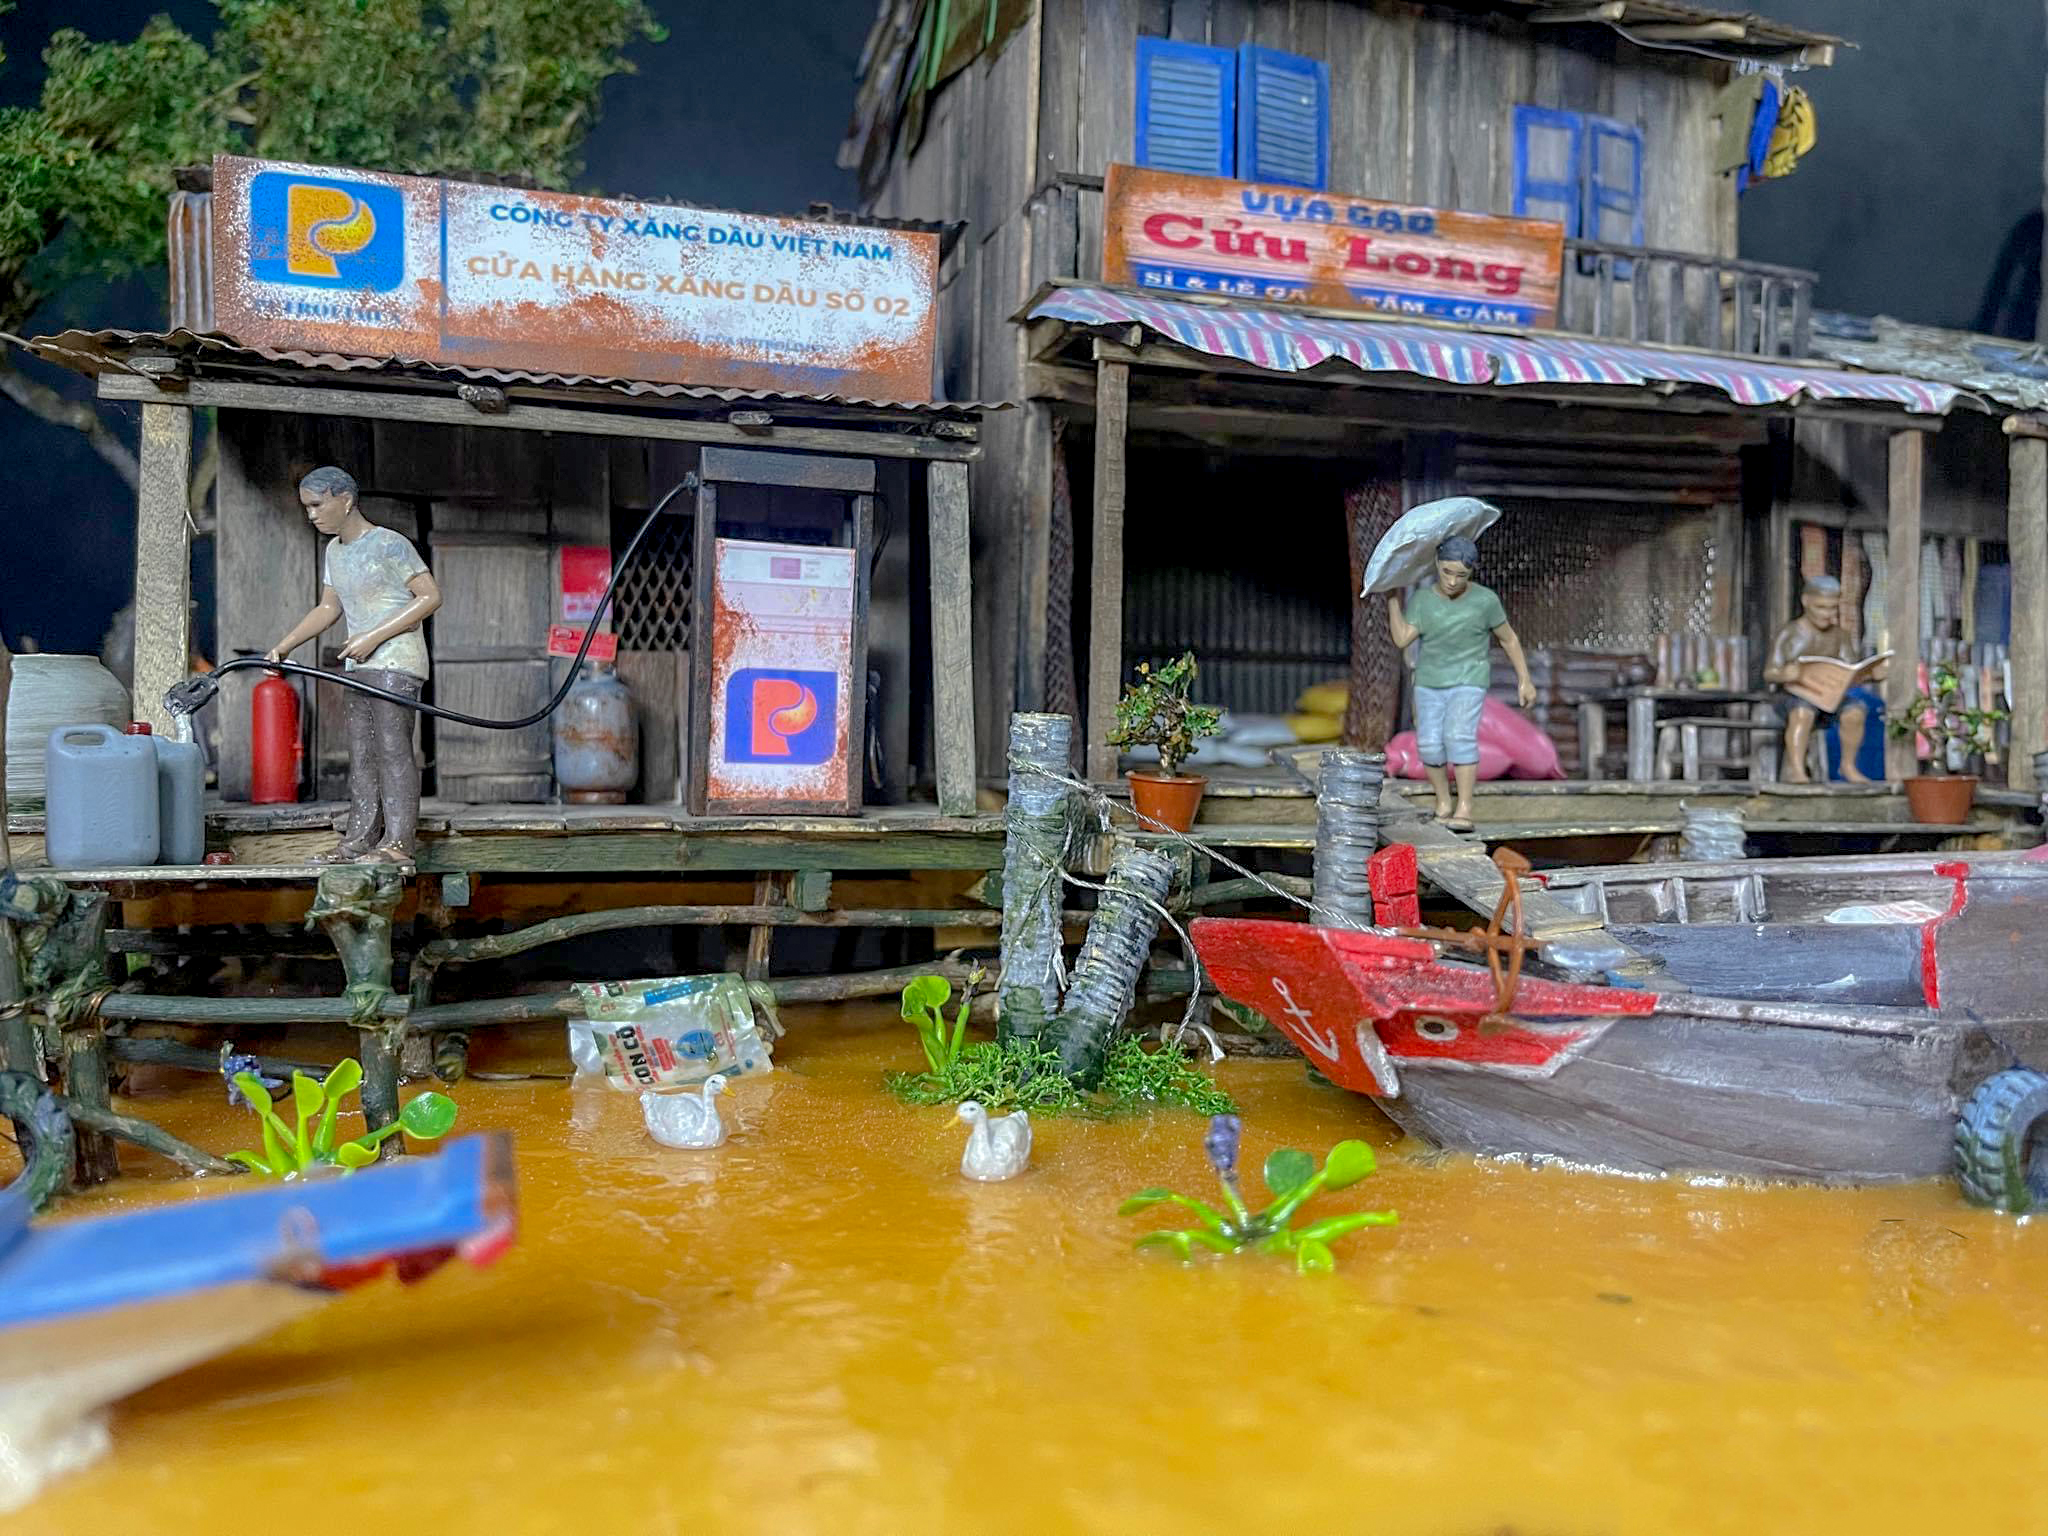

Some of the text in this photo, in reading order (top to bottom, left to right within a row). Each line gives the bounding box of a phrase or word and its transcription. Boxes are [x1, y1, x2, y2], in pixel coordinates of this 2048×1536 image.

[489, 202, 574, 229] CÔNG
[581, 212, 615, 233] TY
[708, 223, 764, 248] DẦU
[770, 232, 827, 257] VIỆT
[832, 240, 893, 262] NAM
[1143, 212, 1525, 296] Cửu Long
[467, 250, 544, 282] CỬA
[551, 261, 647, 291] HÀNG
[655, 271, 745, 301] XĂNG
[753, 279, 817, 307] DẦU
[873, 296, 910, 317] 02
[1185, 275, 1207, 290] &
